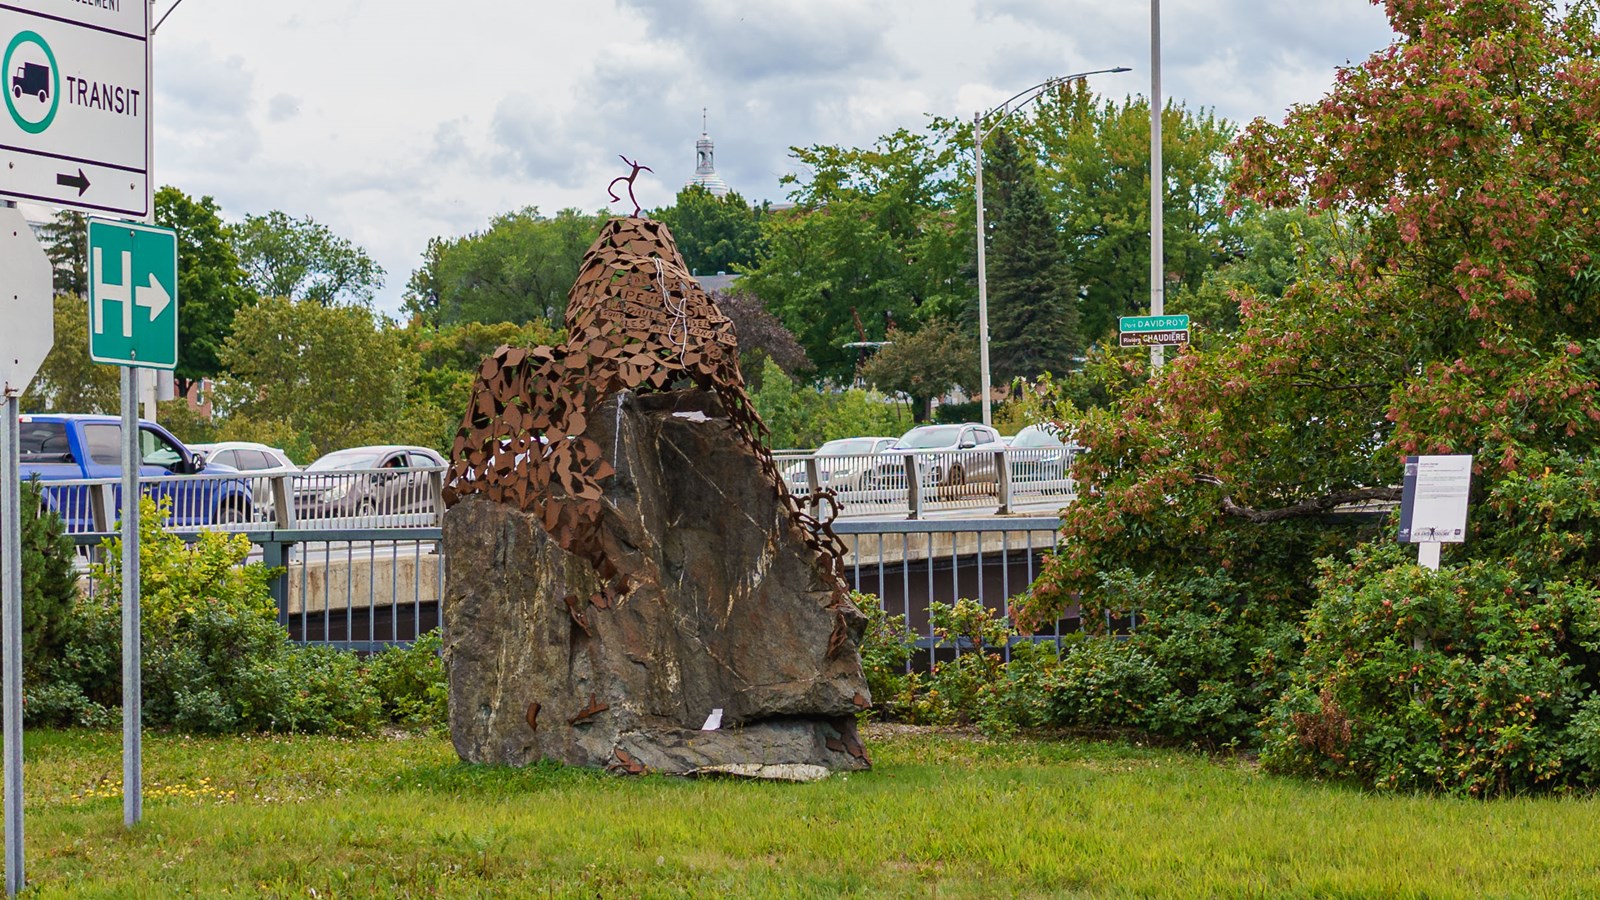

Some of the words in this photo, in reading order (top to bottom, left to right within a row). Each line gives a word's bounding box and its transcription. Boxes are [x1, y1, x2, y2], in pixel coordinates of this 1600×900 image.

[66, 76, 140, 117] TRANSIT
[93, 247, 132, 337] H
[627, 306, 663, 321] GAULE
[625, 319, 646, 328] LES
[1137, 319, 1165, 328] DAVID
[1166, 318, 1185, 327] ROY
